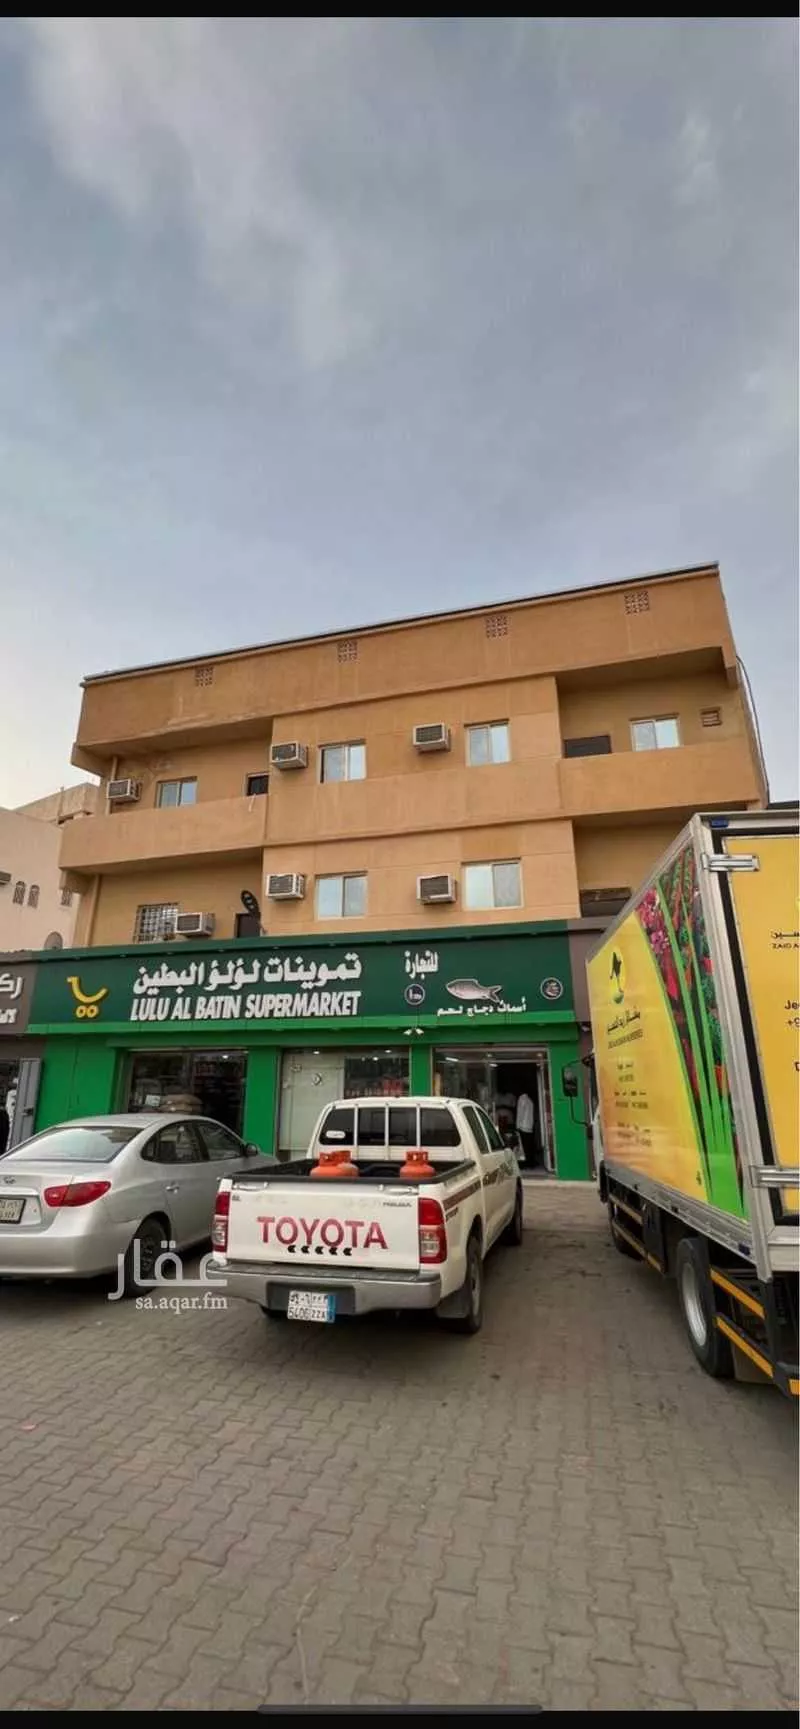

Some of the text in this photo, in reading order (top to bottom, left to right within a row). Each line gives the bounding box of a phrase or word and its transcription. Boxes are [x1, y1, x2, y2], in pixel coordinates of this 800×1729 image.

[132, 952, 362, 996] تموينات لؤلؤ البطين
[404, 950, 439, 980] للتجارة
[130, 991, 362, 1020] LULU AL BATIN SUPERMARKET
[256, 1216, 388, 1250] TOYOTA
